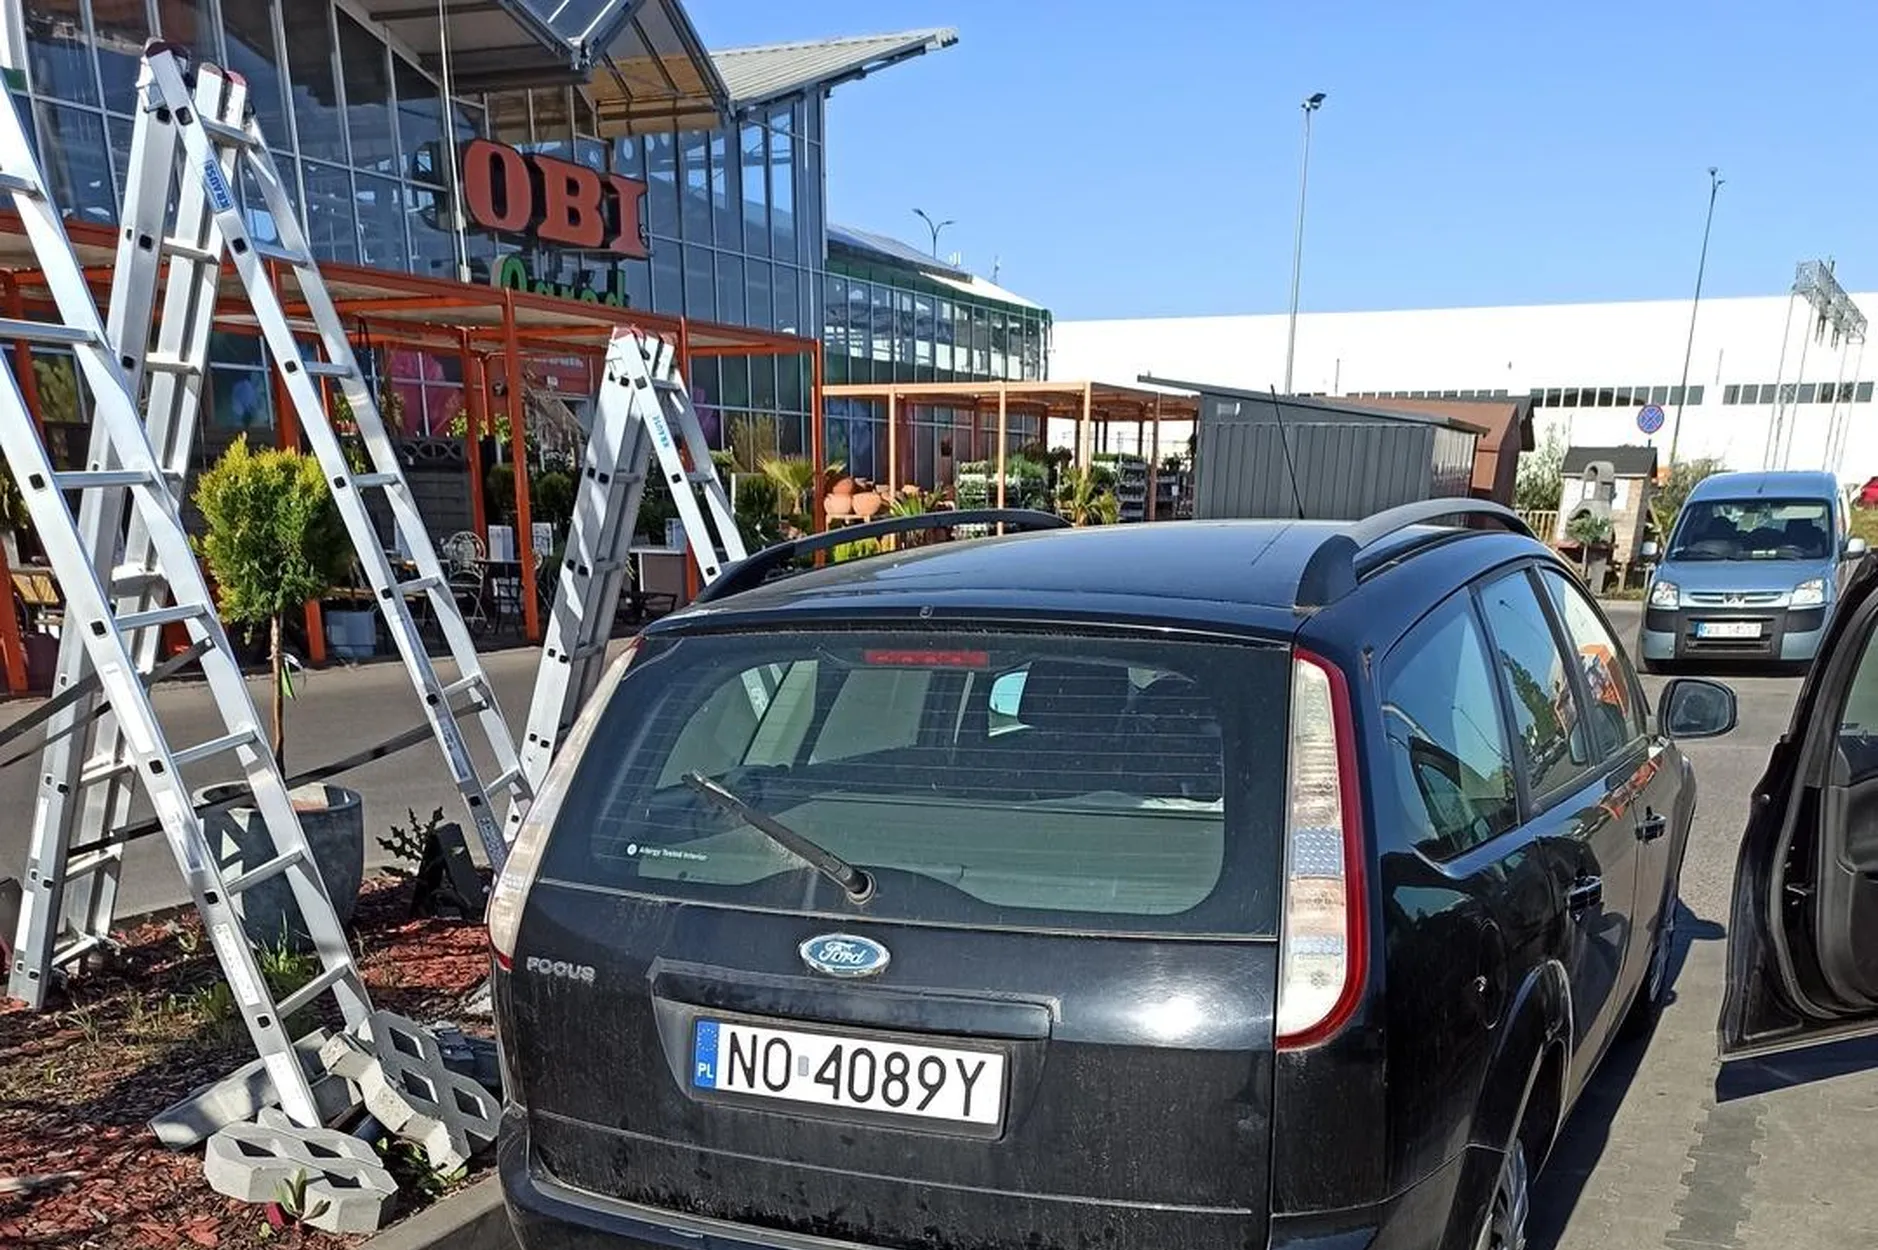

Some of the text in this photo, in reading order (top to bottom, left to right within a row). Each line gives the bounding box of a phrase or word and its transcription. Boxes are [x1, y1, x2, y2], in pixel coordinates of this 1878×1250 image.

[204, 162, 230, 208] KRAUSE
[464, 139, 649, 259] OBI
[526, 956, 596, 982] FOCUS
[819, 941, 867, 964] Ford
[698, 1063, 714, 1079] PL
[727, 1031, 986, 1117] NO 4089Y
